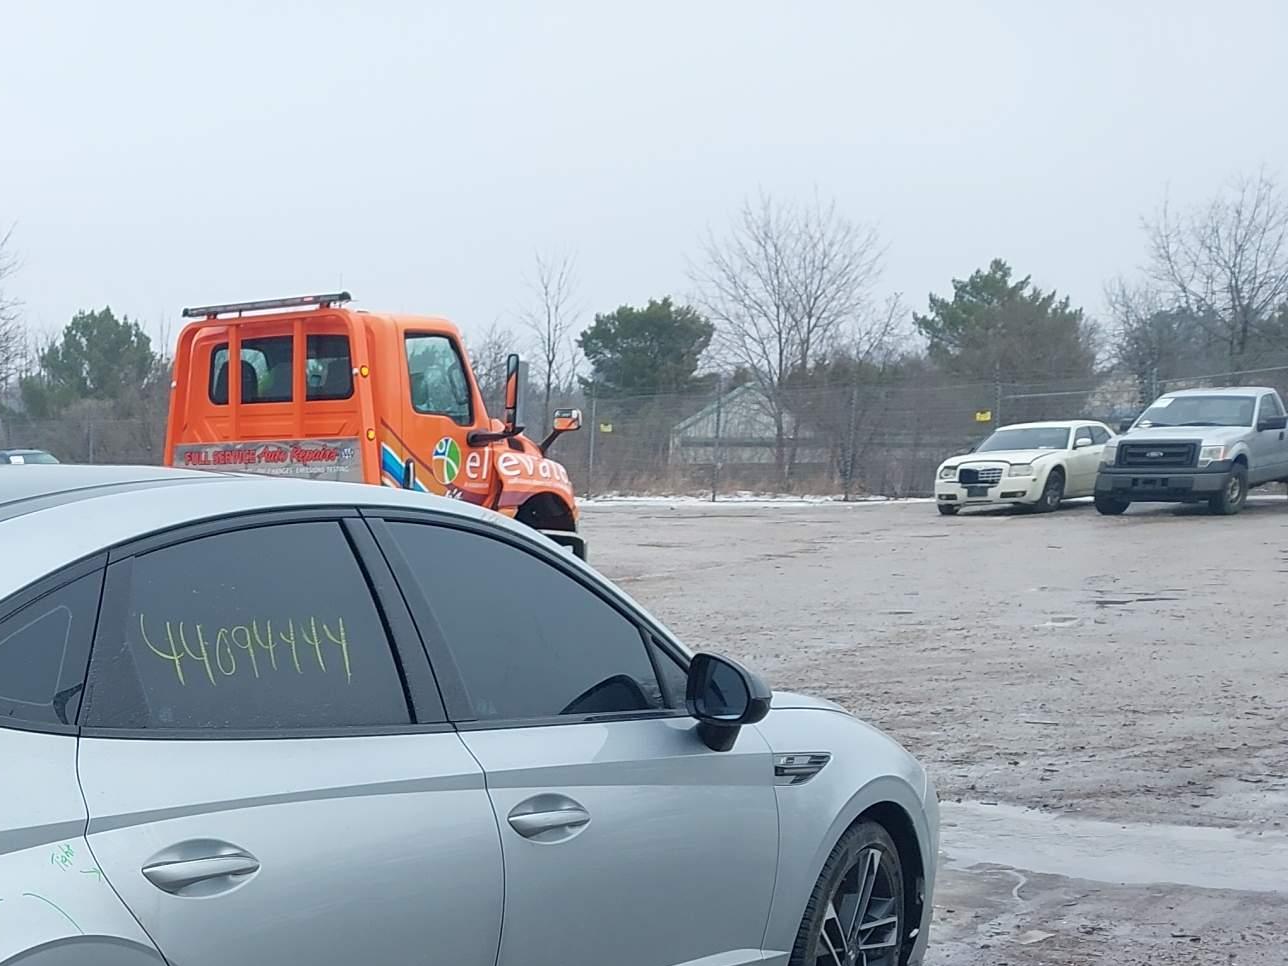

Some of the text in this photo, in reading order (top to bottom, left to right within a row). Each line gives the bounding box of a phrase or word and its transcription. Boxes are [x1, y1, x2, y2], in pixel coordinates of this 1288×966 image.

[184, 443, 339, 467] FULL SERVICE Auto Repairs
[139, 613, 352, 686] 44094444
